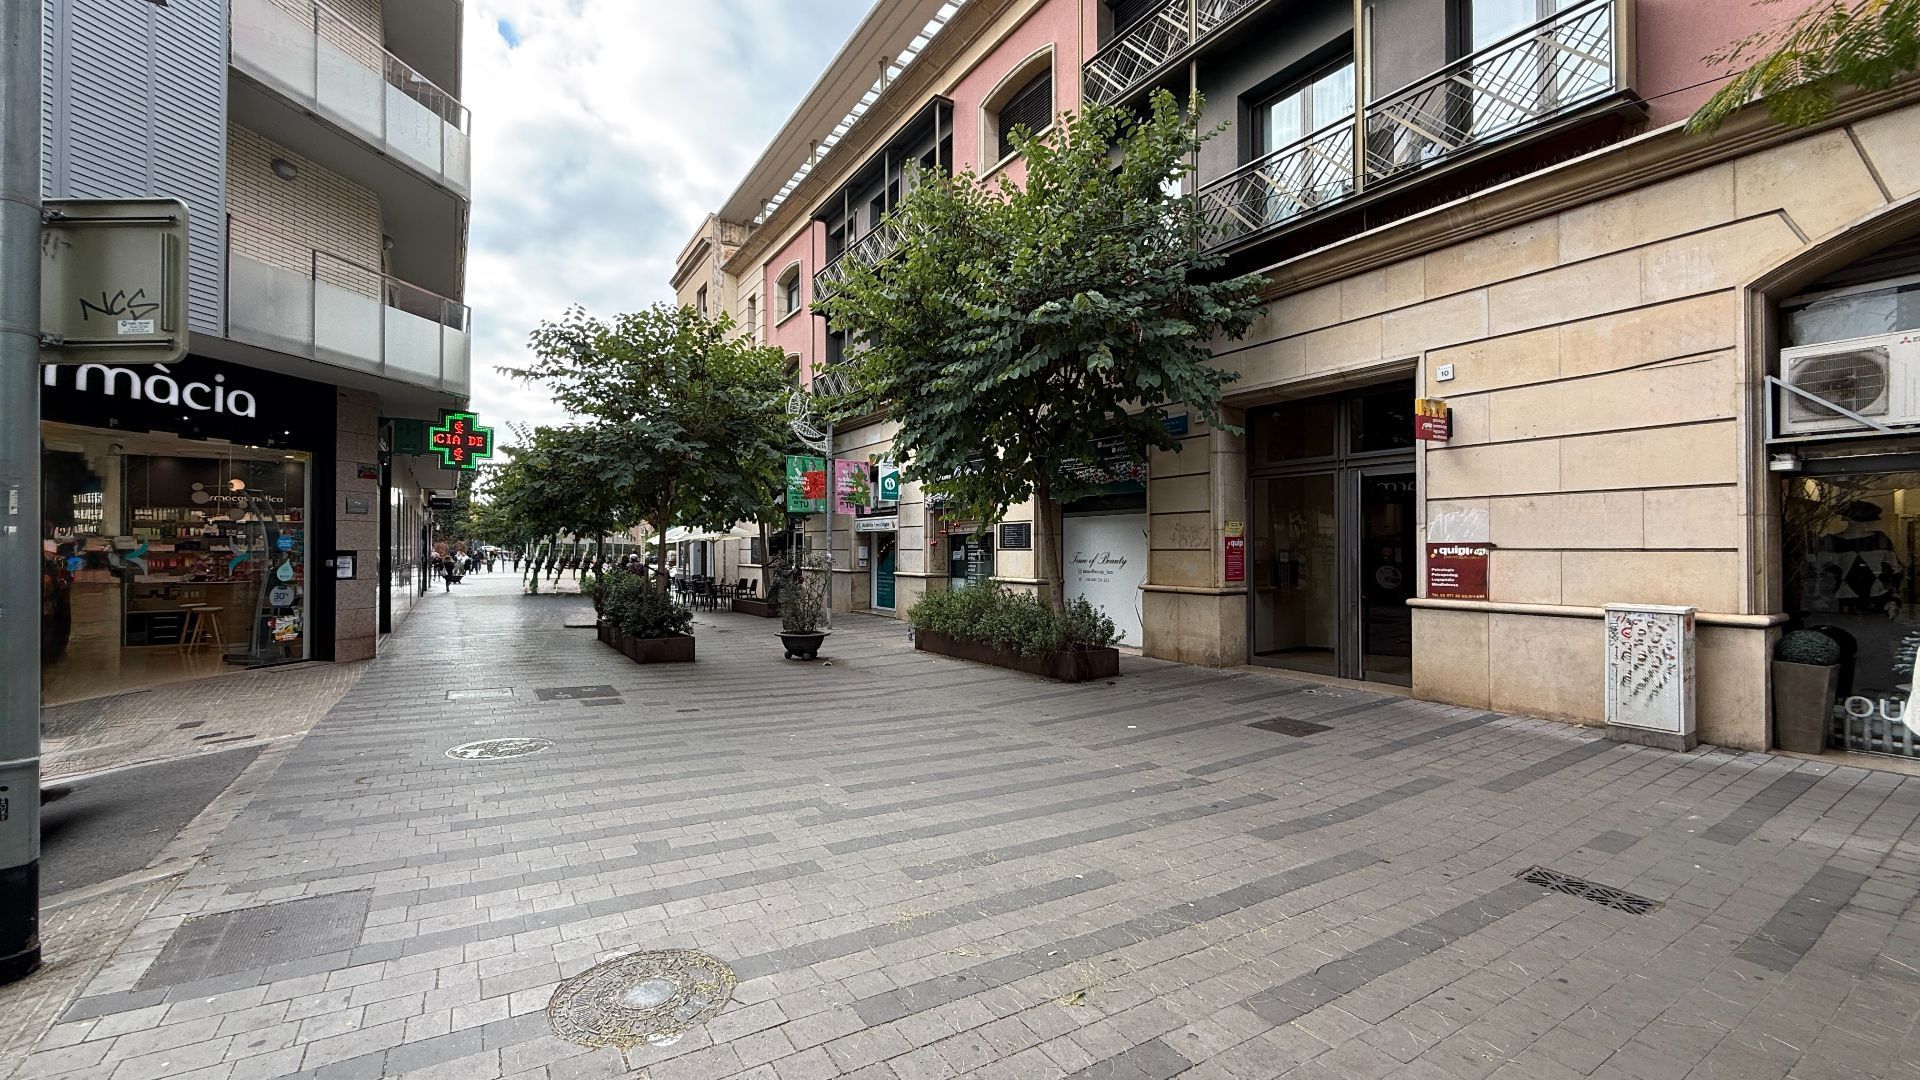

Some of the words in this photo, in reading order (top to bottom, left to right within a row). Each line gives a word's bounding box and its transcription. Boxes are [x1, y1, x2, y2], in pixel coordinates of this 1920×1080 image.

[468, 435, 483, 447] DE
[800, 500, 809, 508] TU
[845, 501, 854, 509] TU
[1088, 552, 1100, 568] of
[1098, 551, 1128, 570] Beauty
